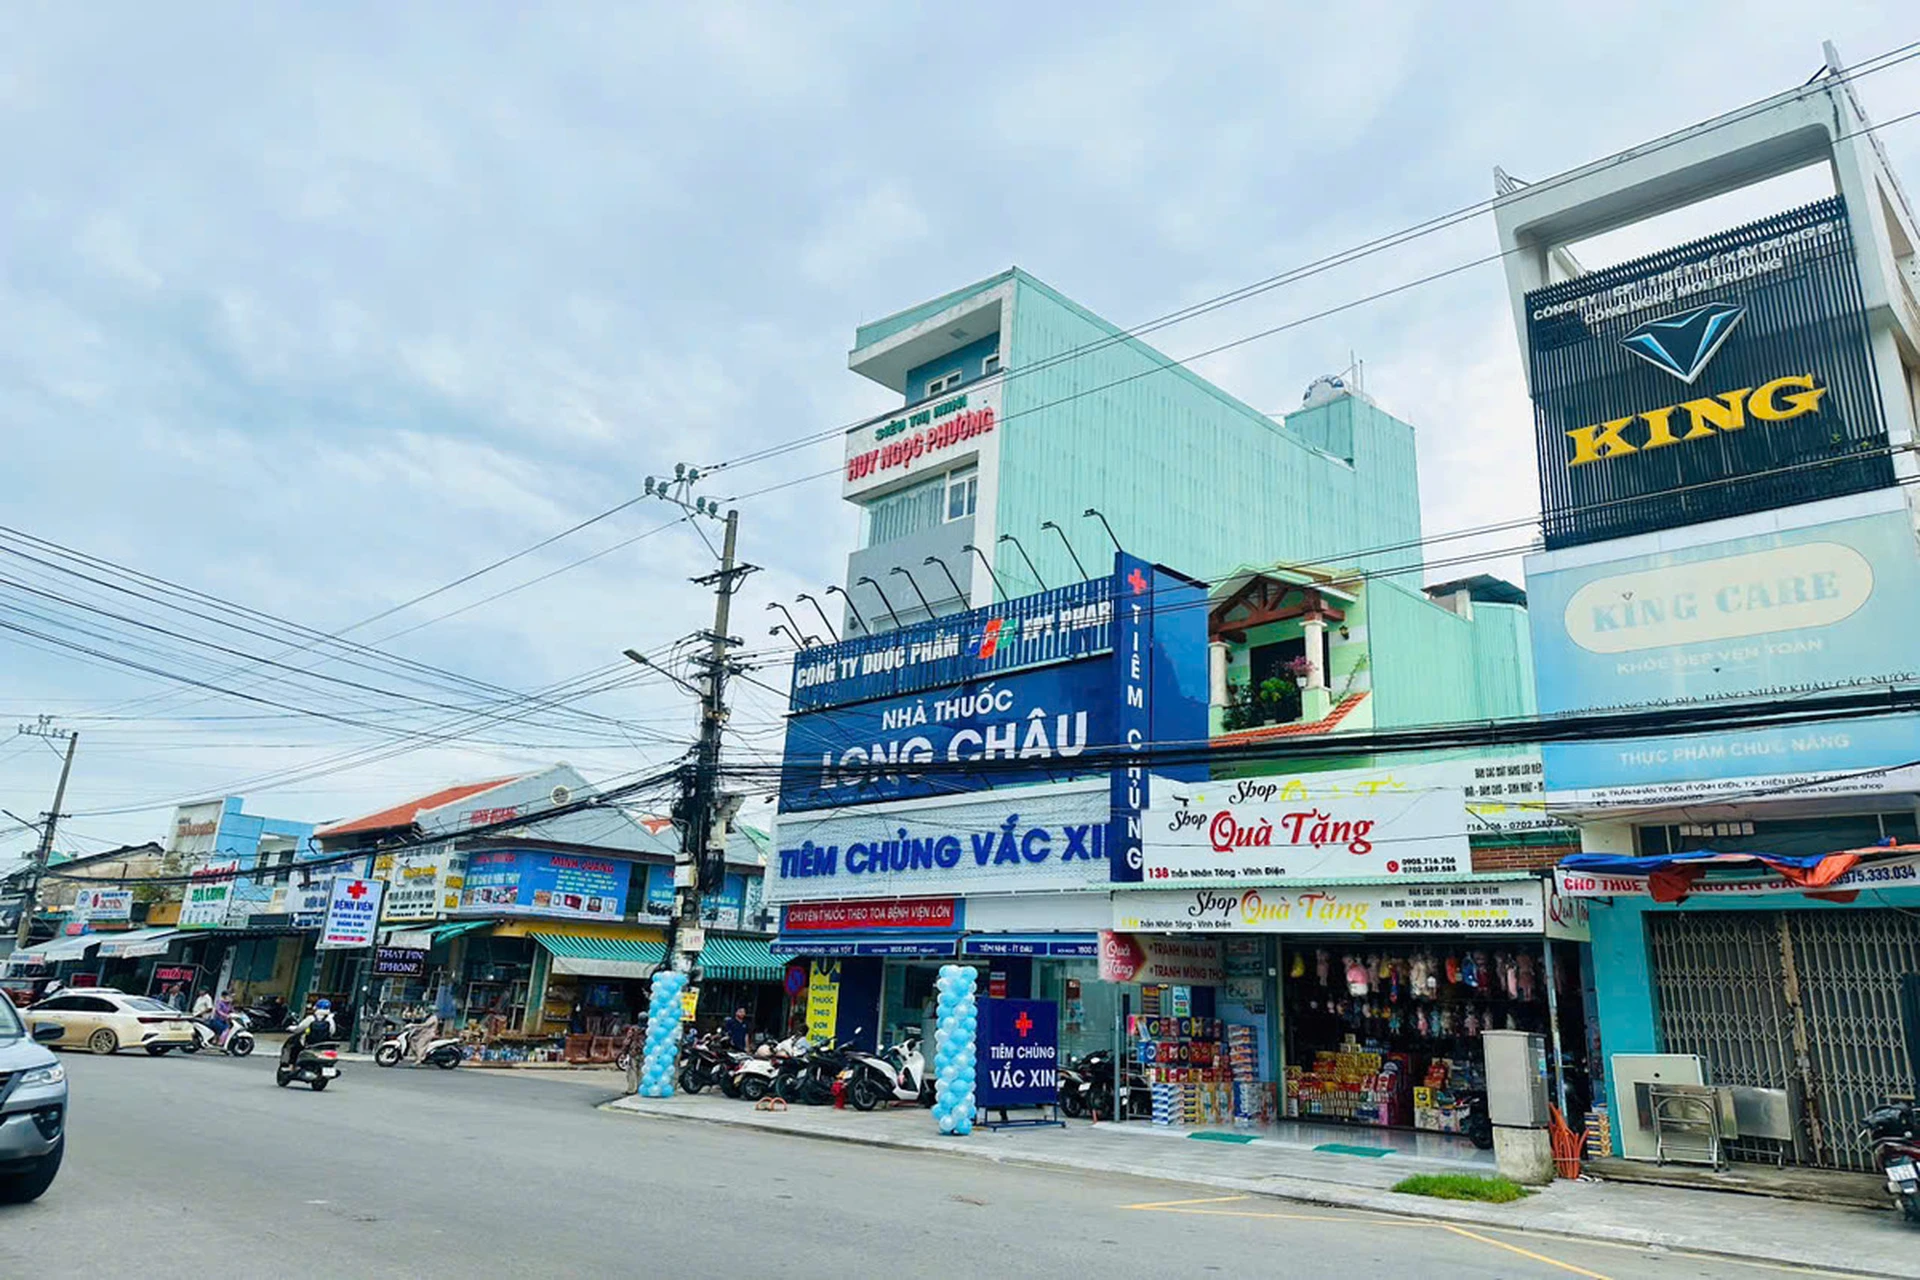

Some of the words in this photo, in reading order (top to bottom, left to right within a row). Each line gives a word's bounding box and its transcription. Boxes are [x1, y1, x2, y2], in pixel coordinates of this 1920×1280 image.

[1565, 373, 1828, 468] KING
[847, 448, 879, 482] HUY
[880, 432, 925, 469] NGỌC
[1591, 592, 1699, 633] KING
[1714, 570, 1842, 614] CARE
[967, 624, 1016, 648] FPT
[1023, 613, 1056, 641] FPT
[795, 657, 836, 689] CÔNG
[840, 656, 860, 680] TY
[861, 647, 906, 675] DƯỢC
[909, 629, 960, 665] PHẨM
[881, 698, 927, 731] NHÀ
[933, 682, 1015, 722] THUỐC
[819, 734, 935, 789] LONG
[947, 706, 1088, 764] CHÂU
[1228, 779, 1278, 805] Shop
[1169, 810, 1208, 832] Shop
[1209, 810, 1274, 853] Quà
[1281, 807, 1375, 856] Tặng
[778, 840, 839, 879] TIÊM
[845, 827, 962, 874] CHỦNG
[970, 813, 1051, 866] VẮC
[1060, 823, 1111, 861] XI
[1148, 867, 1170, 879] 138
[1563, 877, 1597, 891] CHO
[334, 898, 355, 911] BỆNH
[356, 899, 375, 913] VIỆN
[847, 906, 868, 920] THEO
[869, 906, 886, 920] TOA
[887, 904, 910, 922] BỆNH
[910, 904, 931, 921] VIỆN
[1187, 890, 1238, 917] Shop
[1240, 889, 1292, 924] Quà
[1298, 889, 1370, 930] Tặng
[1397, 919, 1461, 928] 0905.716.706
[1467, 918, 1535, 928] 0702.589.585
[378, 948, 406, 960] THAY
[405, 949, 425, 960] PIN
[1153, 942, 1181, 955] TRANH
[378, 962, 419, 974] IPHONE
[1154, 964, 1181, 979] TRANH
[990, 1042, 1015, 1060] TIÊM
[1016, 1041, 1056, 1060] CHỦNG
[989, 1060, 1026, 1089] VẮC
[1029, 1069, 1056, 1088] XIN
